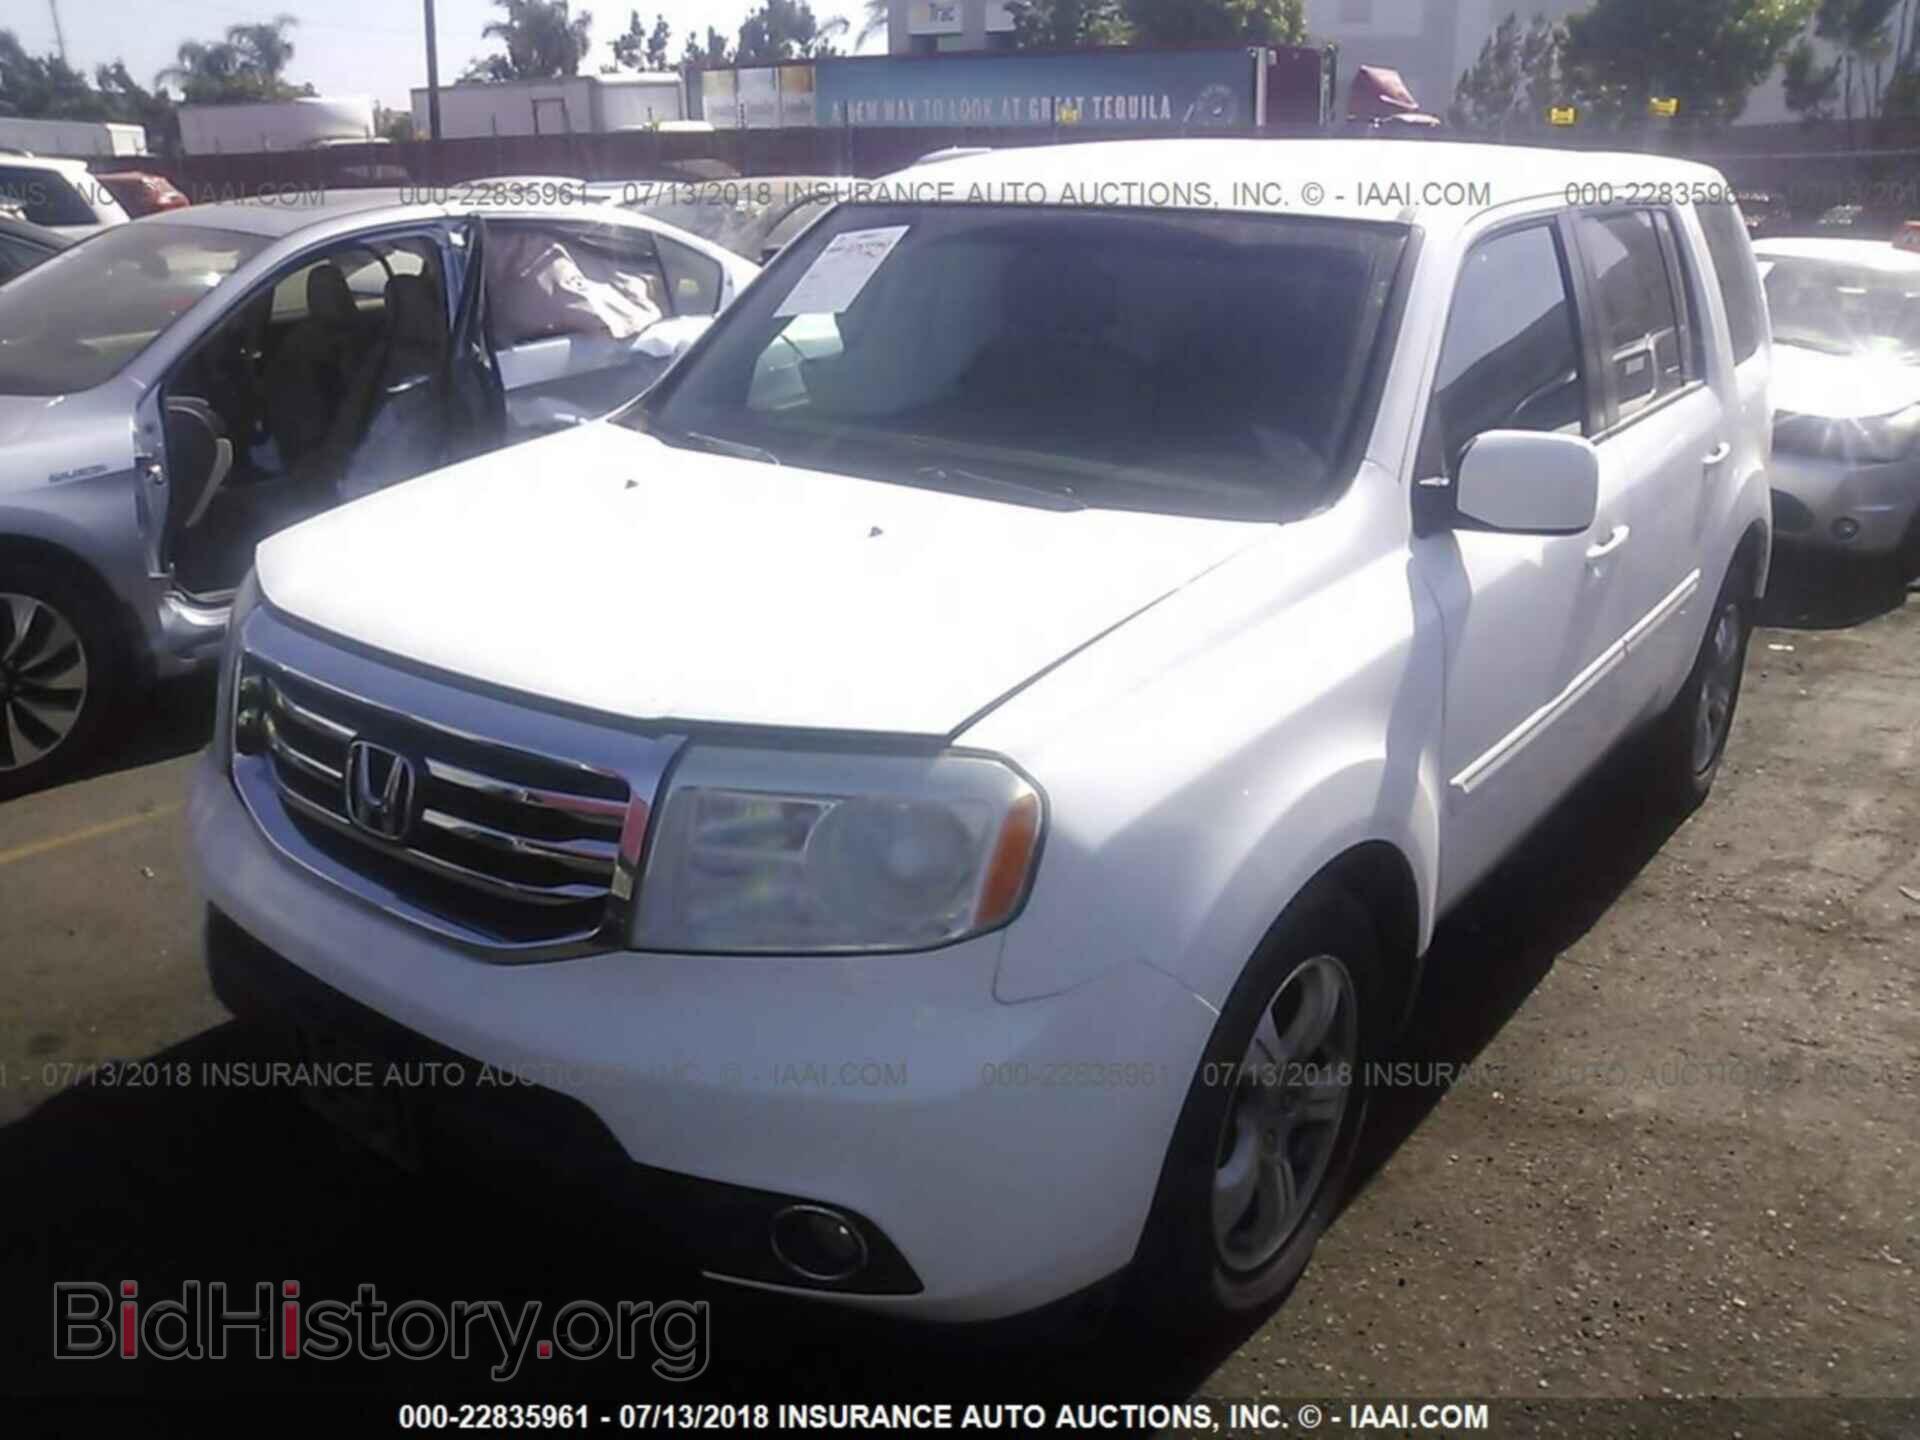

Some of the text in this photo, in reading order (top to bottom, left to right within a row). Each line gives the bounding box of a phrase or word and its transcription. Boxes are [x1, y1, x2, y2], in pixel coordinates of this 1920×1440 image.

[884, 98, 916, 121] WAY
[923, 98, 945, 121] TO
[949, 97, 992, 121] LOOK
[1001, 97, 1021, 121] AT
[1028, 96, 1084, 121] GREAT
[1093, 95, 1171, 121] TEQUILA
